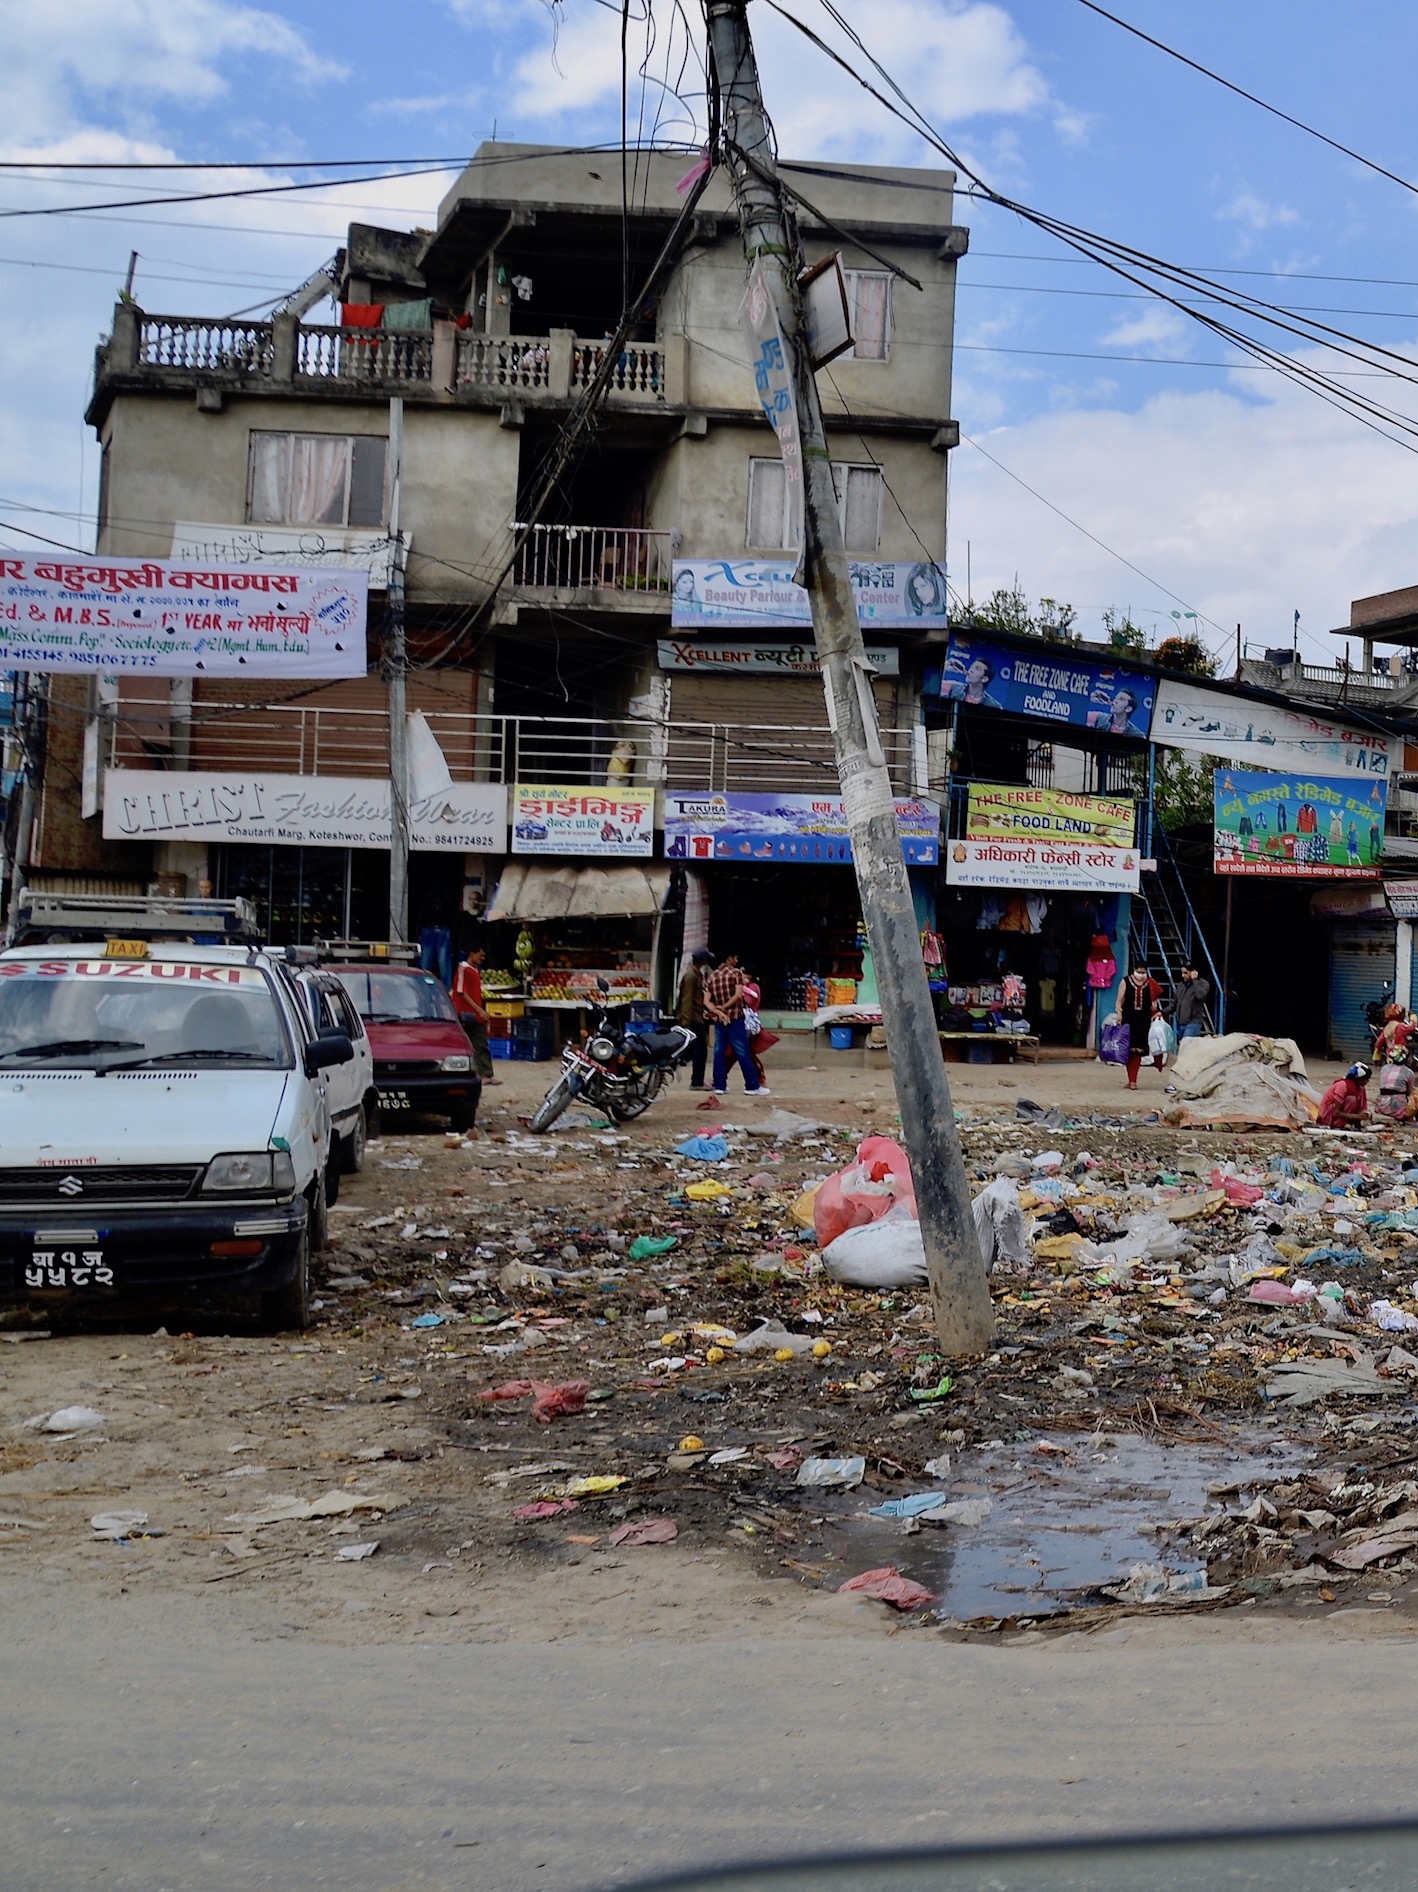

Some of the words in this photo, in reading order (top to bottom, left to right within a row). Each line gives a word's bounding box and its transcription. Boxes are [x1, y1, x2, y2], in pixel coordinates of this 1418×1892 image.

[34, 562, 165, 593] बहुमुखी
[169, 571, 300, 593] क्याम्पस
[705, 589, 746, 604] Beauty
[750, 589, 793, 602] Parlour
[796, 590, 805, 602] &
[861, 591, 900, 604] Center
[28, 604, 47, 621] &
[184, 613, 223, 631] YEAR
[671, 642, 750, 666] XCELLENT
[1014, 660, 1029, 684] THE
[1029, 664, 1048, 688] FREE
[1049, 668, 1070, 692] ZONE
[1070, 672, 1092, 696] CAFE
[1024, 695, 1071, 716] FOODLAND
[1041, 690, 1057, 700] AND
[1341, 731, 1388, 753] बजार
[974, 791, 1002, 807] THE
[1007, 791, 1043, 803] FREE
[1055, 793, 1093, 810] ZONE
[1097, 802, 1132, 822] CAFE
[1012, 815, 1051, 829] FOOD
[1055, 818, 1092, 834] LAND
[277, 828, 306, 841] Marg,
[309, 829, 367, 843] Koteshwor,
[434, 835, 494, 847] 9841724925
[975, 845, 1039, 864] अधिकारी
[1041, 850, 1082, 866] फेन्सी
[1085, 851, 1117, 868] स्टोर
[109, 942, 145, 955] TAXI
[36, 962, 240, 984] SUZUKI
[32, 1252, 55, 1267] बा
[82, 1251, 103, 1266] ज
[25, 1267, 114, 1288] ५५८२
